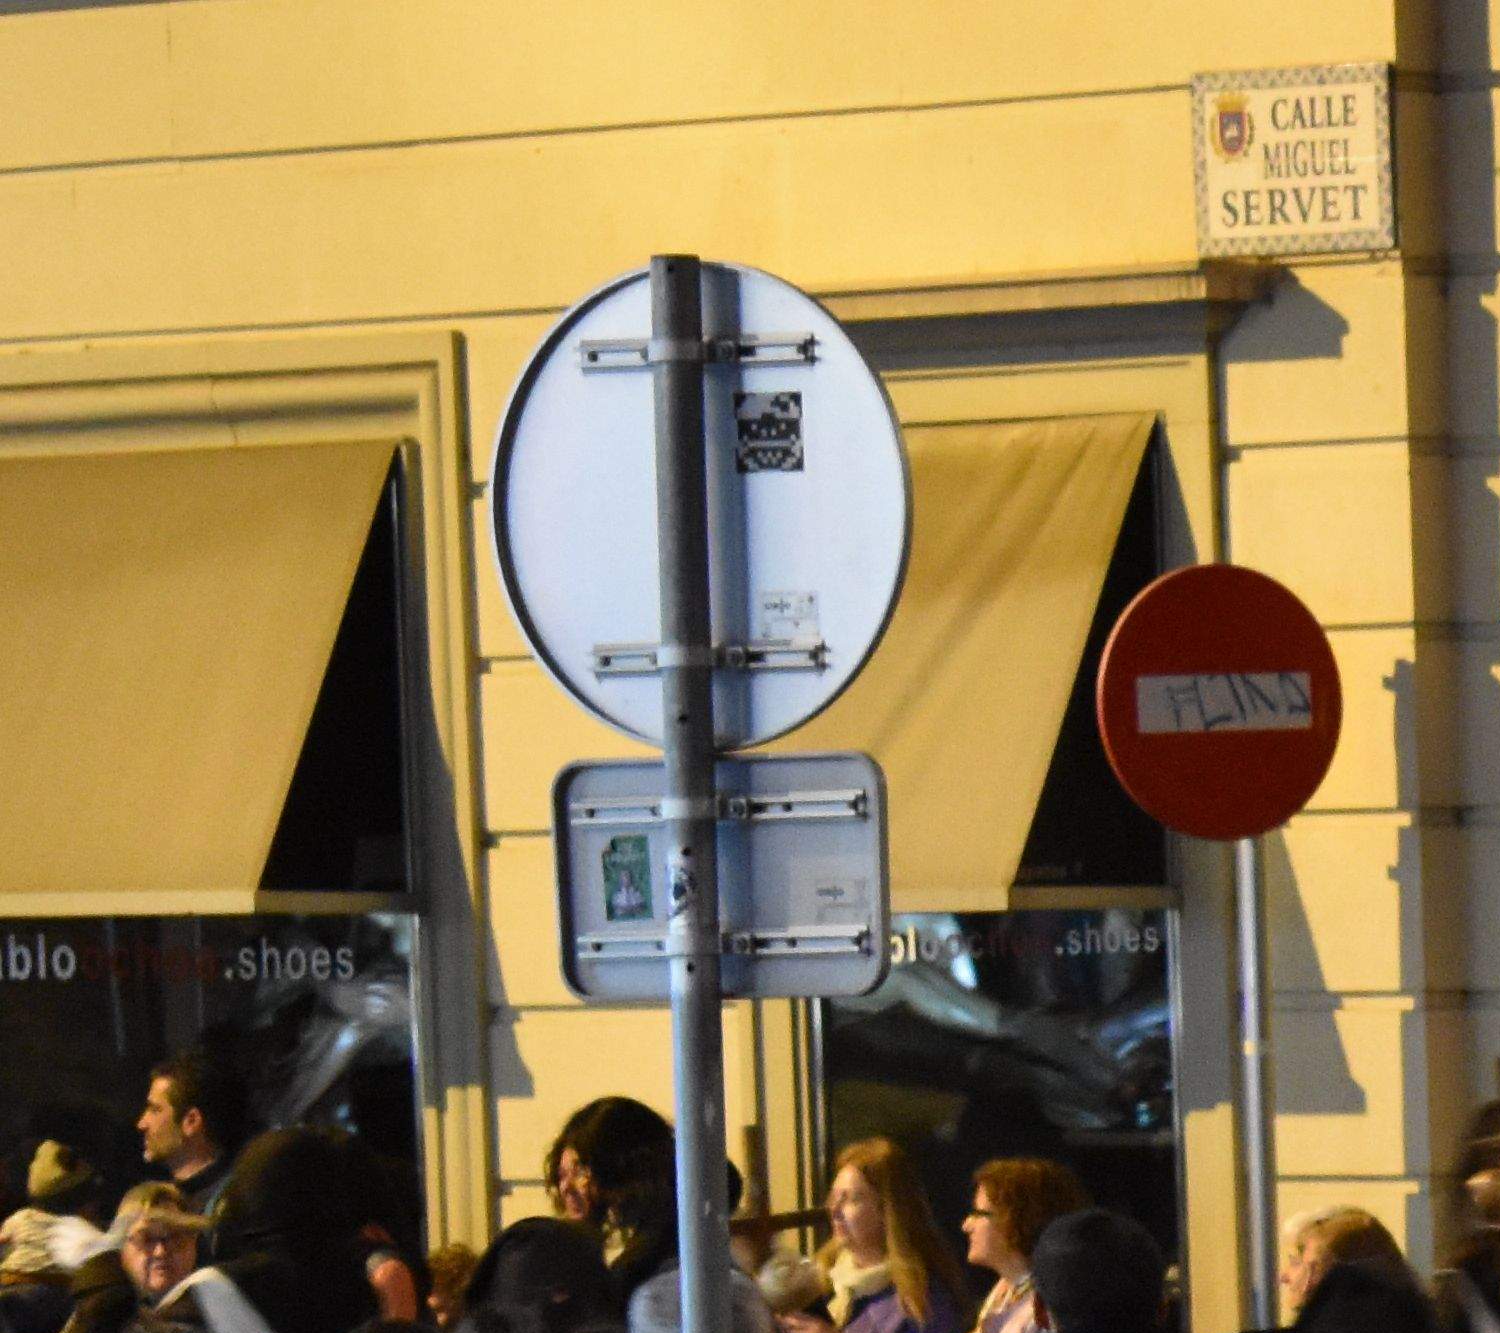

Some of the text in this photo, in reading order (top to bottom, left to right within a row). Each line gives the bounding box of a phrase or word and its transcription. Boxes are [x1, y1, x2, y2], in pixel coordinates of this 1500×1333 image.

[1271, 94, 1357, 130] CALLE
[1262, 138, 1357, 180] MIGUEL
[1221, 183, 1368, 228] SERVET
